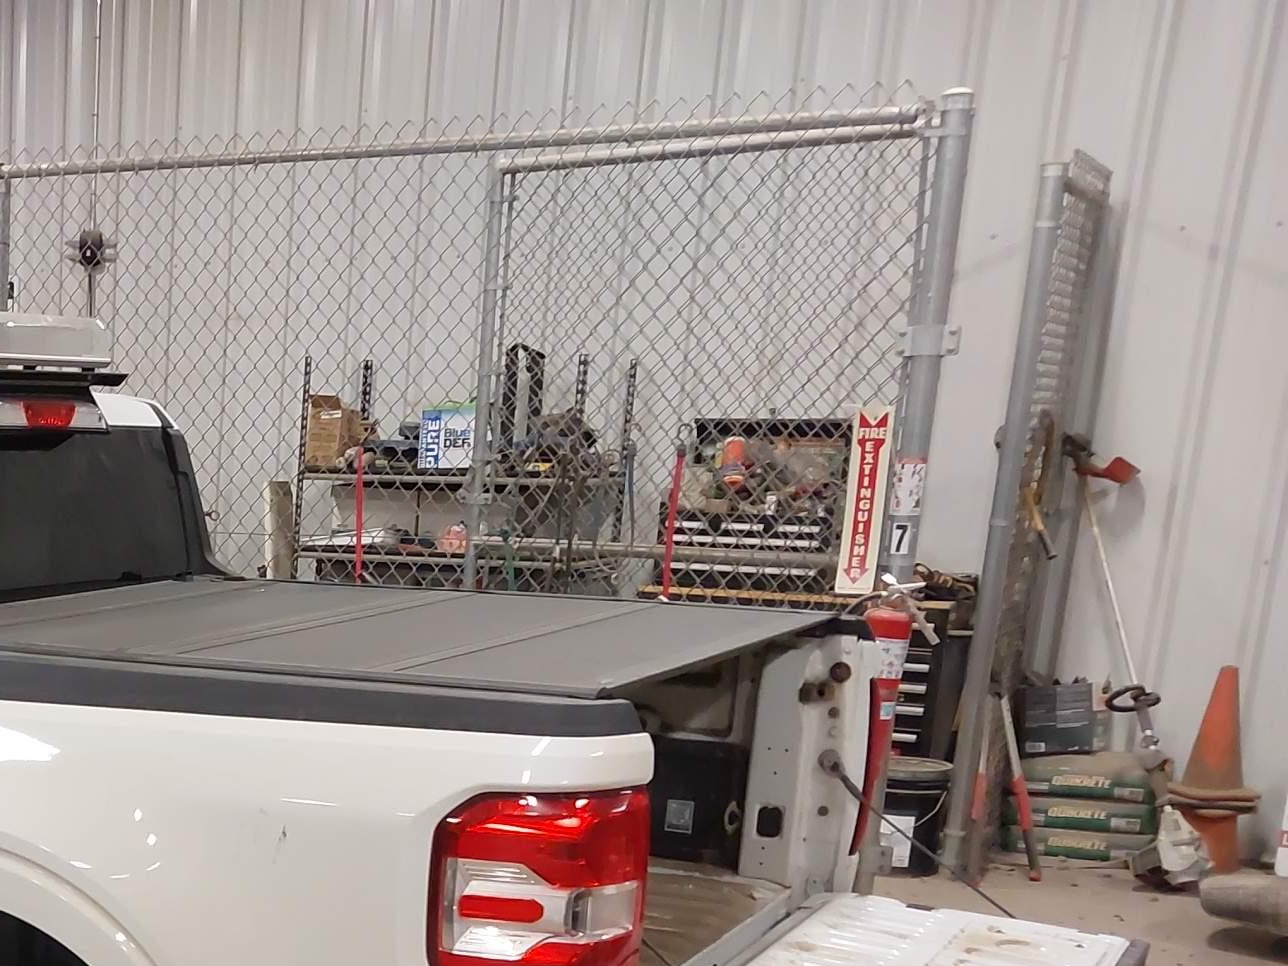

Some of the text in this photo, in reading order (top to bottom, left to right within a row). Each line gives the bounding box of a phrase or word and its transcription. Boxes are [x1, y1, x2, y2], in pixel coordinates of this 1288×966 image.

[425, 419, 441, 469] PURE
[444, 428, 472, 438] Blue
[858, 427, 887, 440] FIRE
[849, 440, 878, 579] EXTINGUISHER
[895, 524, 909, 553] 7
